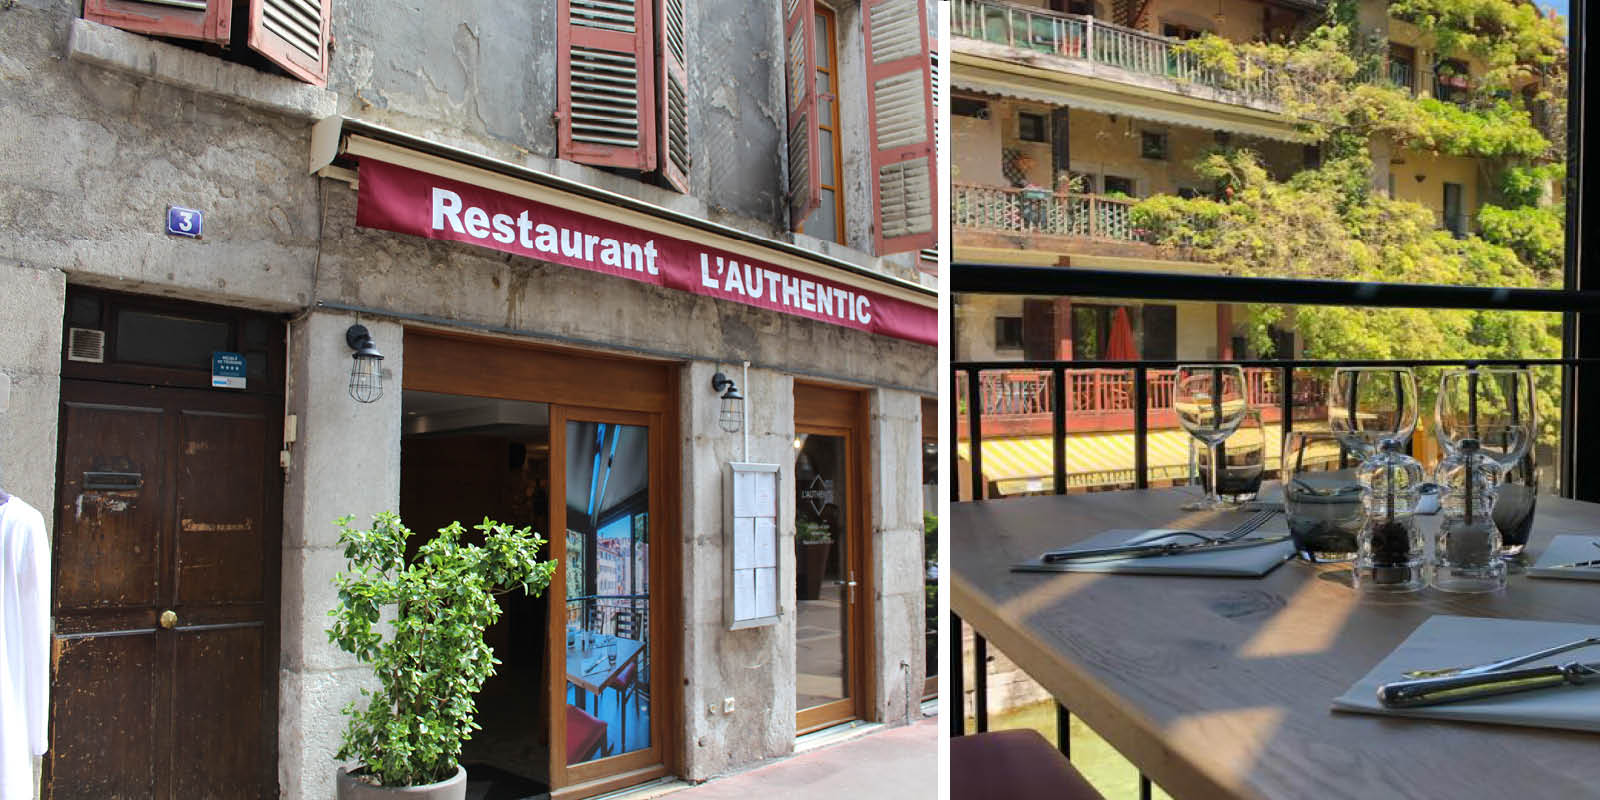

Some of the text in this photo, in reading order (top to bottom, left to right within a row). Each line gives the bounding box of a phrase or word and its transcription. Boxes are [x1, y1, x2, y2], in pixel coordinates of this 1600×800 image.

[179, 211, 193, 232] 3
[432, 187, 872, 325] Restaurant L'AUTHENTIC
